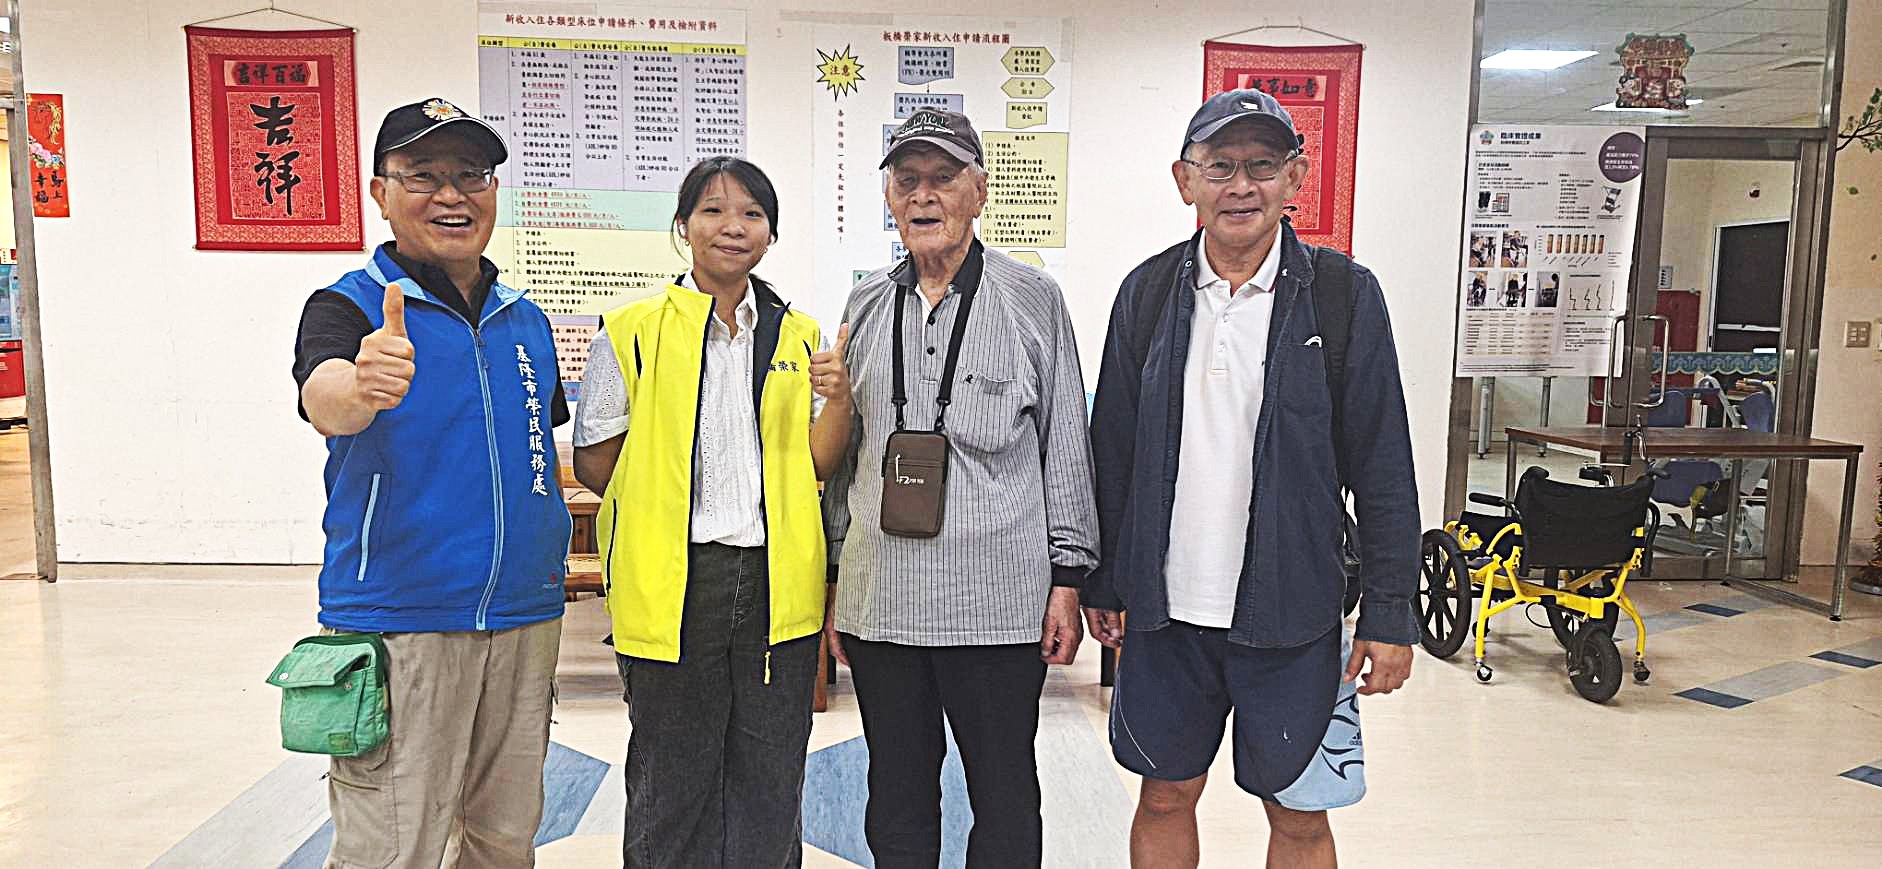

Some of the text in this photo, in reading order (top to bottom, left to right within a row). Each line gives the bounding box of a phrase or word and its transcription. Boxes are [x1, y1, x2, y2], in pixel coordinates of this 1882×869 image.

[883, 30, 1010, 44] 板橋榮家新收入住申請流程圖
[238, 63, 306, 85] 吉祥百福
[830, 64, 851, 77] 注意
[250, 96, 301, 216] 吉祥
[515, 344, 548, 496] 基隆市榮民服務處
